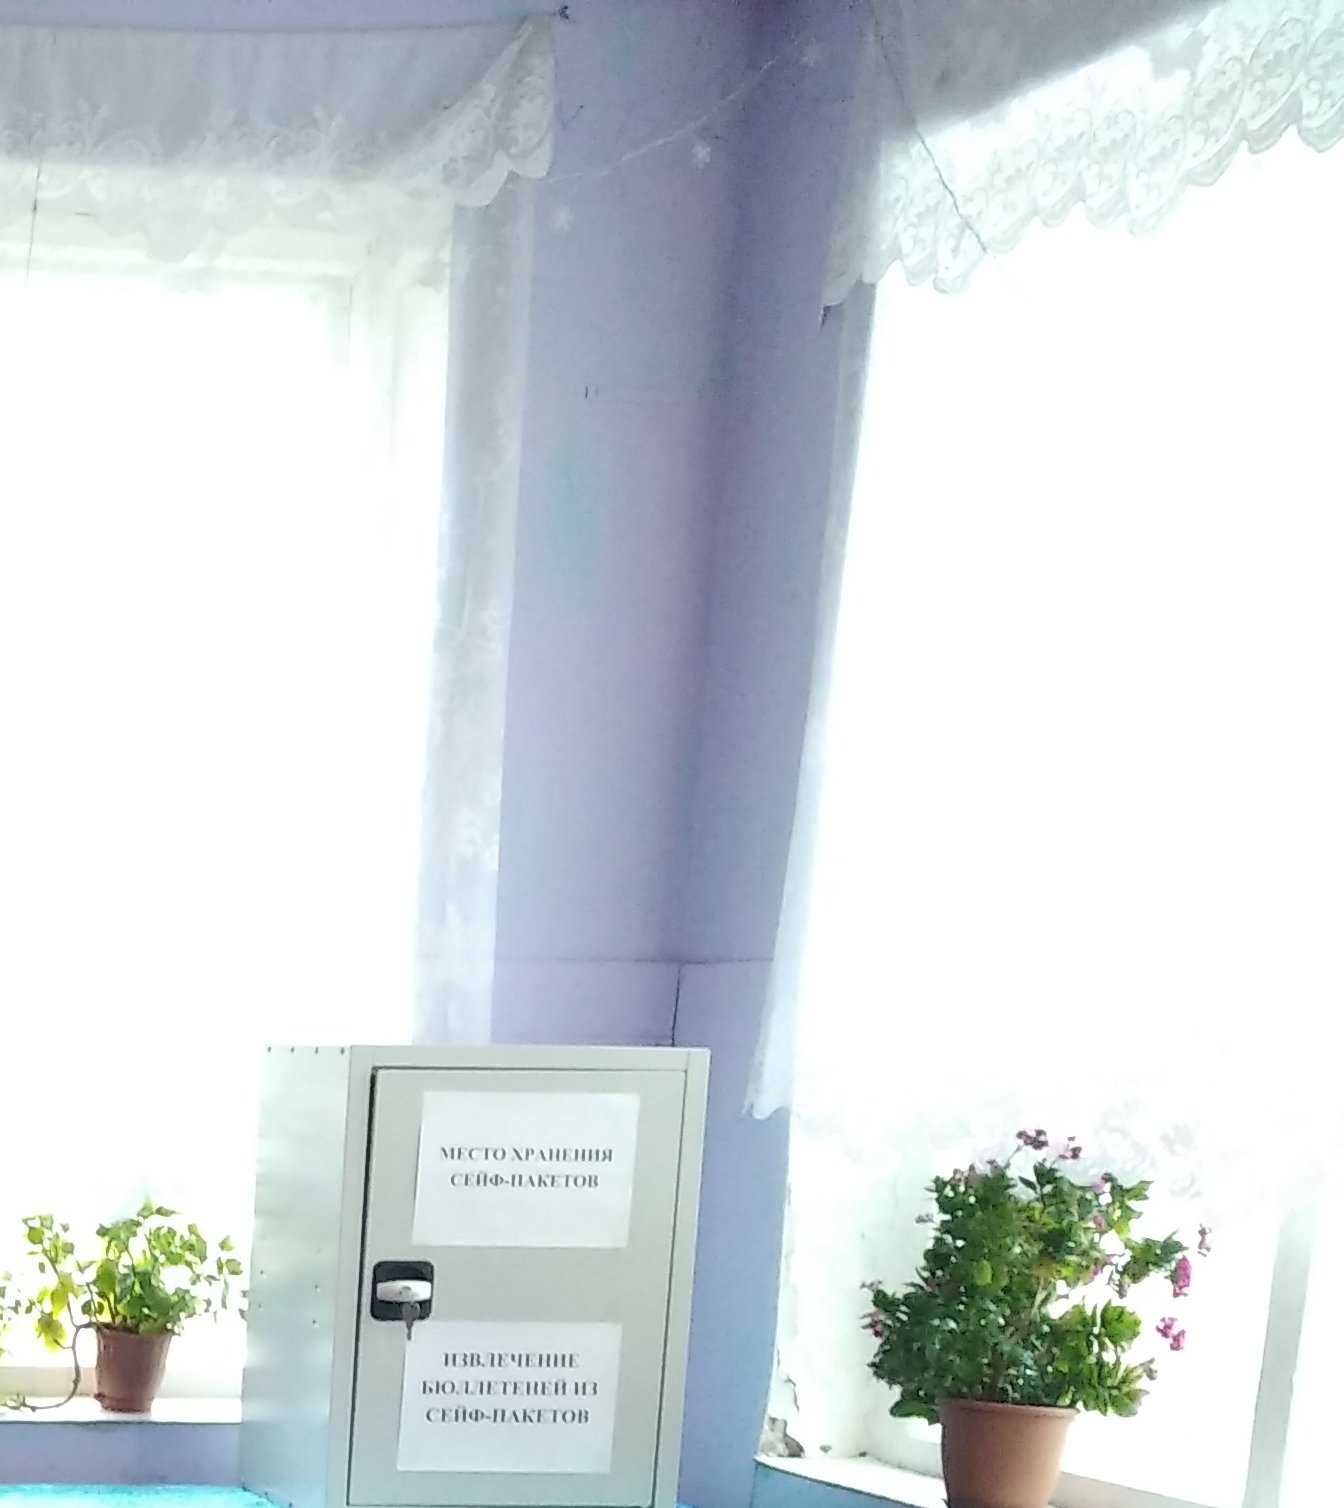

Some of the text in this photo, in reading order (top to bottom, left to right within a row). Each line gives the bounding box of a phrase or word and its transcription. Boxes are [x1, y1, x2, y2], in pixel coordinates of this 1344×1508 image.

[439, 1146, 614, 1163] МЕСТО ХРАНЕНИЯ
[450, 1171, 600, 1189] СЕЙФ-ПАКЕТОВ
[443, 1352, 580, 1369] ИЗВЛЕЧЕНИЕ
[421, 1378, 599, 1397] БЮЛЛЕТЕНЕЙ ИЗ
[425, 1405, 590, 1425] СЕЙФ-ПАКЕТОВ
